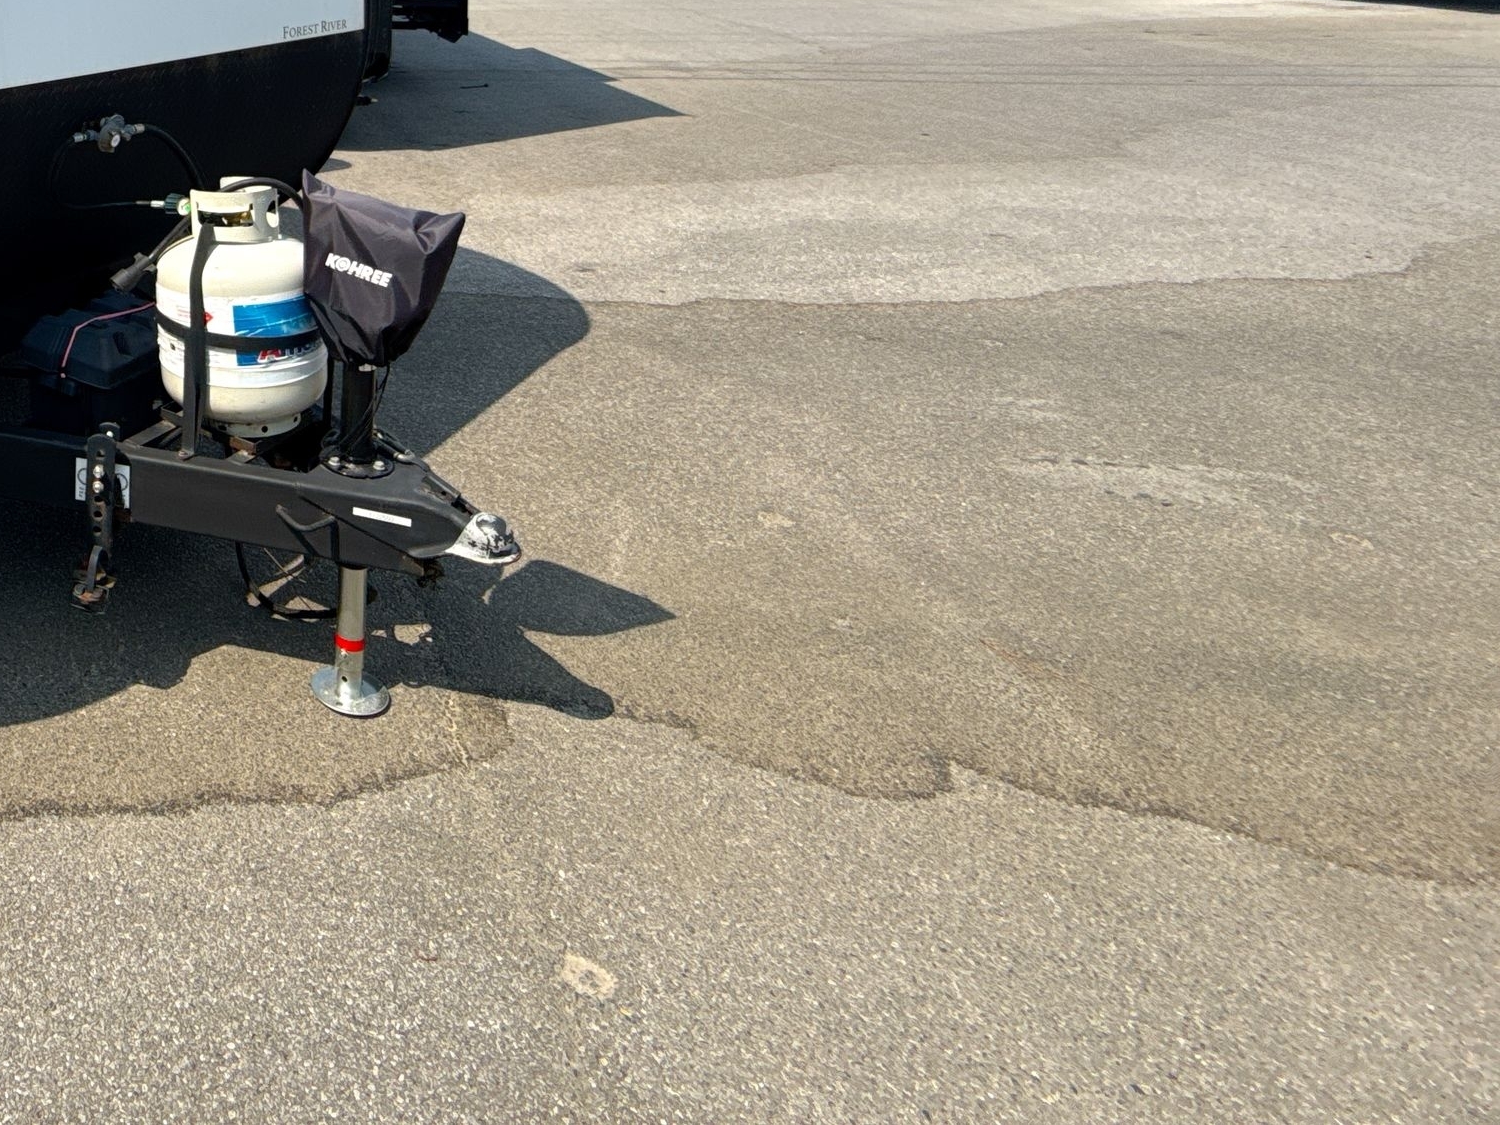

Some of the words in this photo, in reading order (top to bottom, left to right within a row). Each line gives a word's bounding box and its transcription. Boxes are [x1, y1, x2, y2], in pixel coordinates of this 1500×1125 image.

[283, 24, 319, 39] FOREST
[321, 19, 347, 33] RIVER
[325, 252, 393, 288] KOHREE
